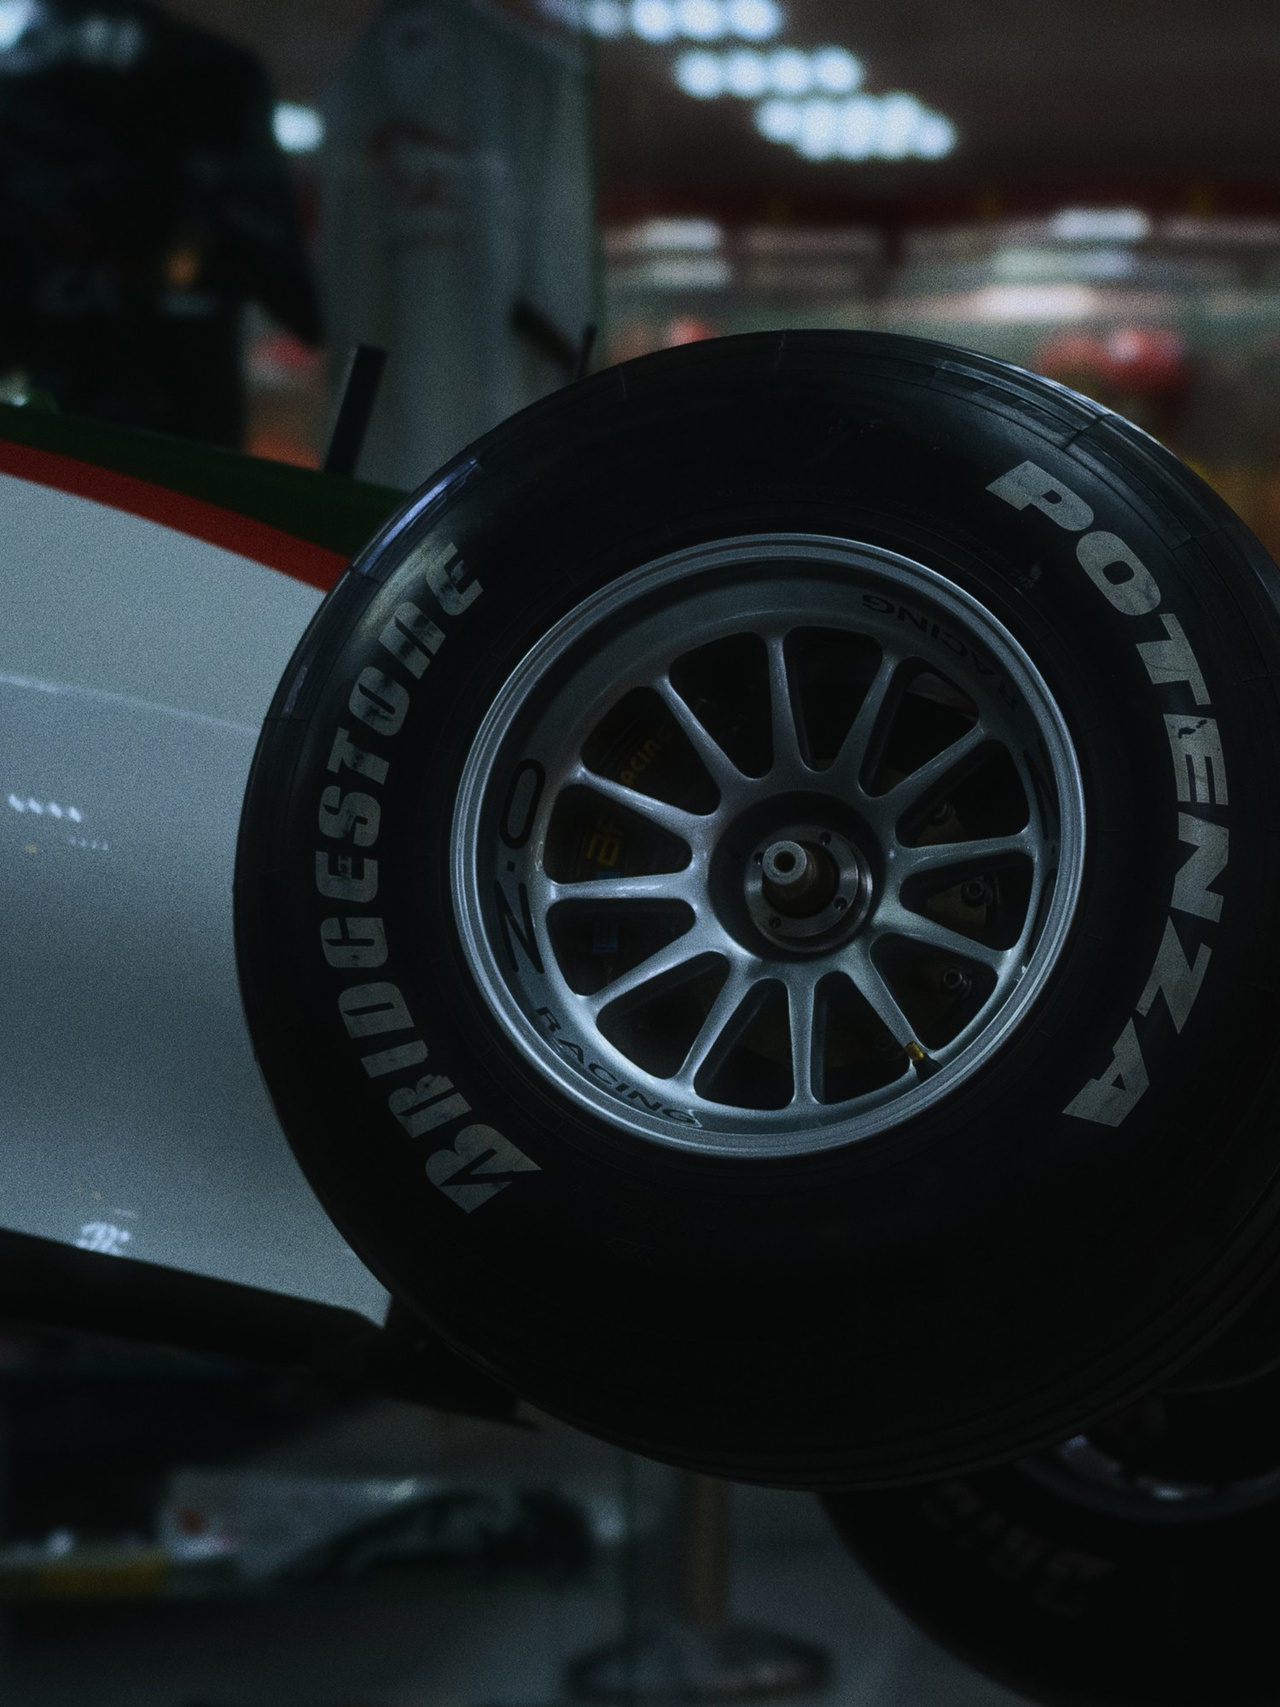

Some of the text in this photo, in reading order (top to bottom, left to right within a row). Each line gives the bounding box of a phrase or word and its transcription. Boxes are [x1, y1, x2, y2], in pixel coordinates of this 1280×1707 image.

[315, 540, 543, 1214] BRIDGESTONE
[536, 1006, 703, 1128] RACING
[985, 459, 1230, 1128] POTENZA
